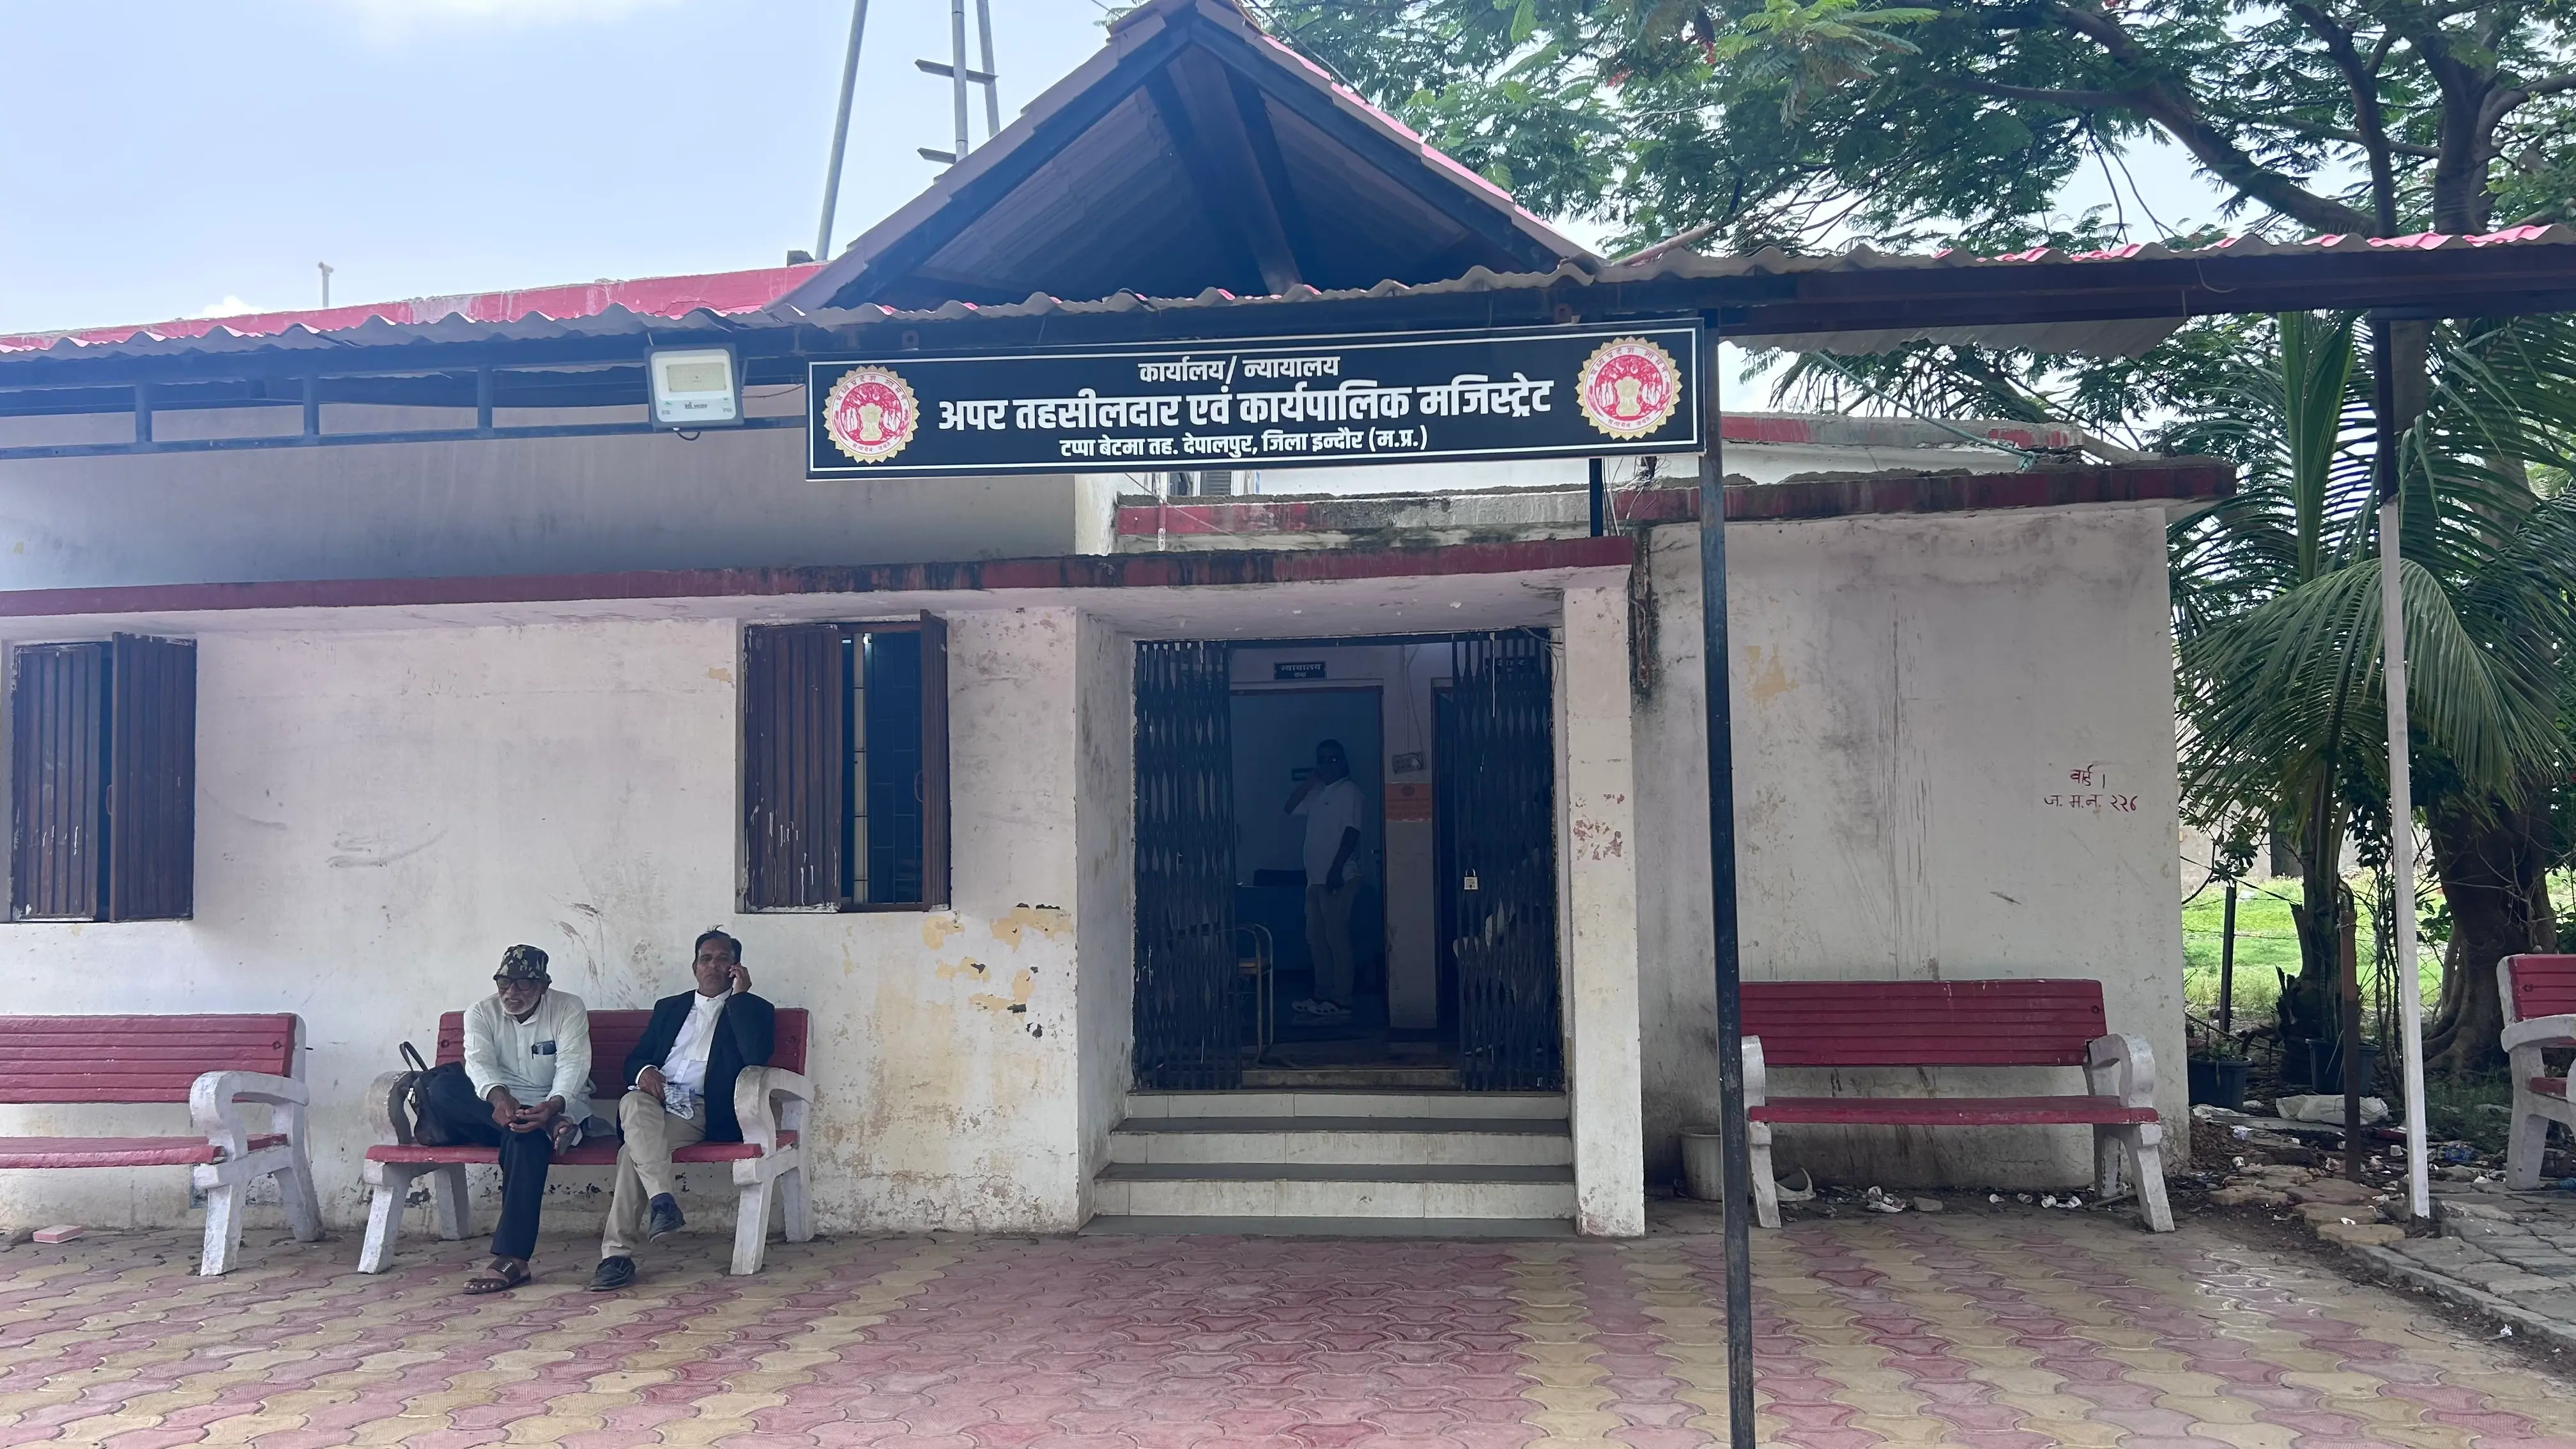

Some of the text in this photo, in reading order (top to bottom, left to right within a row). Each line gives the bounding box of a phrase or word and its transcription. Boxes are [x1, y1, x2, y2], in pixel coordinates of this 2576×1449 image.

[1137, 356, 1341, 385] कार्यालय/ न्यायालय
[939, 372, 1554, 431] अपर तहसीलदार एवं कार्यपालिक मजिस्ट्रेट
[1059, 424, 1428, 458] टप्पा बेटमा तह. देपालपुर, जिला इन्दौर (म.प्र.)
